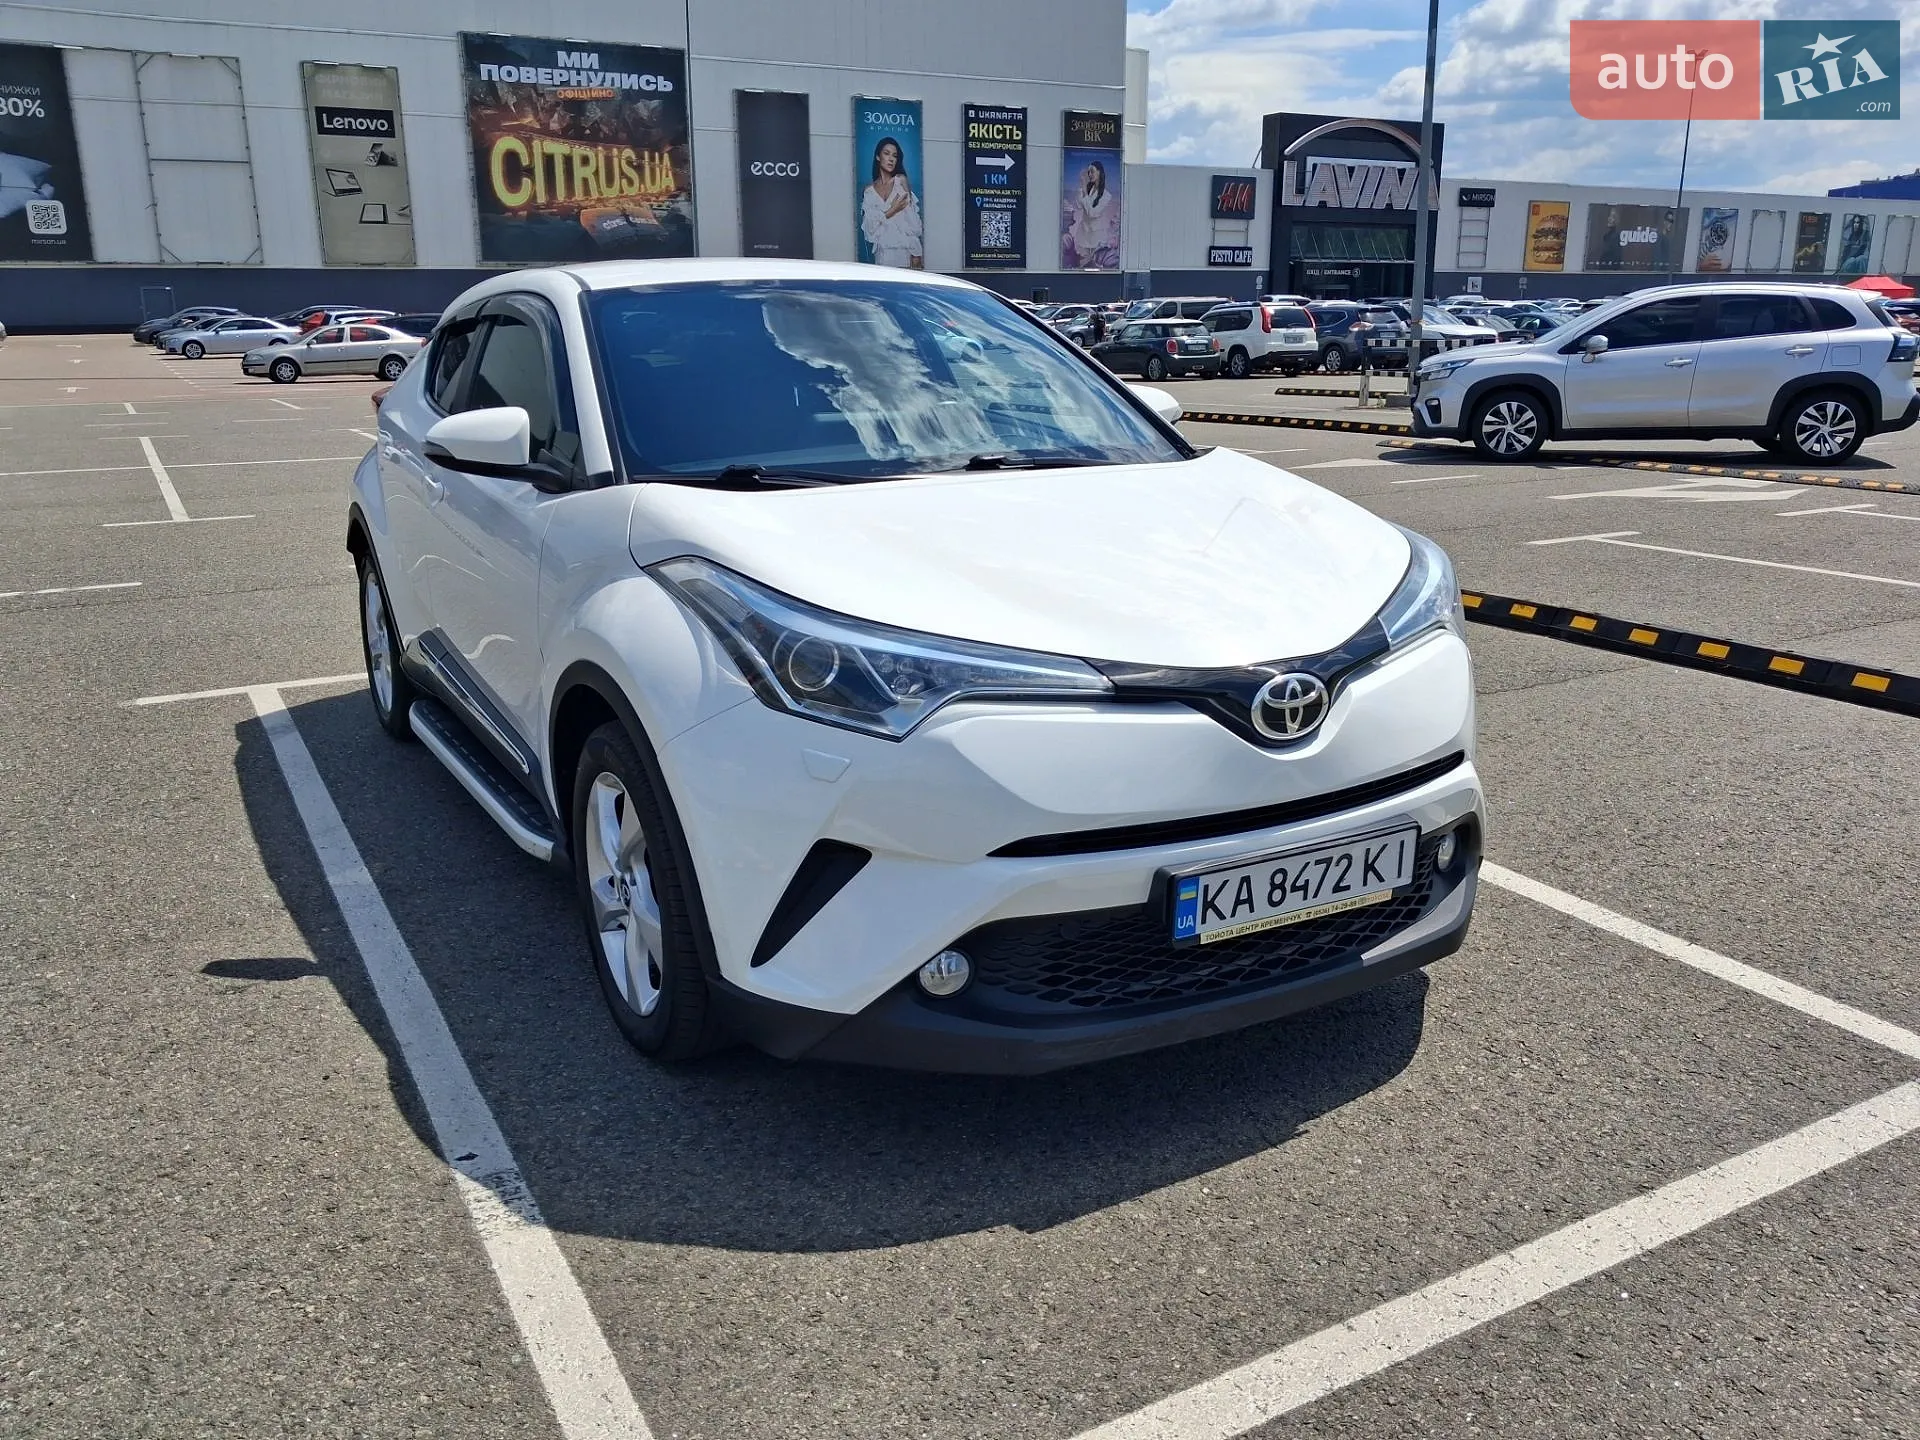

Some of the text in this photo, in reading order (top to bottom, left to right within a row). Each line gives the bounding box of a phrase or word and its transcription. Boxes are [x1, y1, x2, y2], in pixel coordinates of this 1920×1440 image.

[556, 50, 600, 69] МИ
[479, 63, 674, 92] ПОВЕРНУЛИСЬ
[322, 112, 390, 131] Lenovo
[863, 111, 916, 126] ЗОЛОТА
[978, 110, 1024, 121] UKRNAFTA
[968, 122, 1023, 140] ЯКІСТЬ
[1071, 119, 1115, 134] ЗОЛОТИЙ
[1084, 130, 1102, 142] ВІК
[490, 135, 676, 207] CITRUS.UA
[750, 161, 800, 177] ecco
[1619, 226, 1658, 247] guide
[1210, 249, 1233, 263] PESTO
[1177, 840, 1405, 930] UA KA 8472 KI
[1235, 922, 1260, 936] ЦЕНТР
